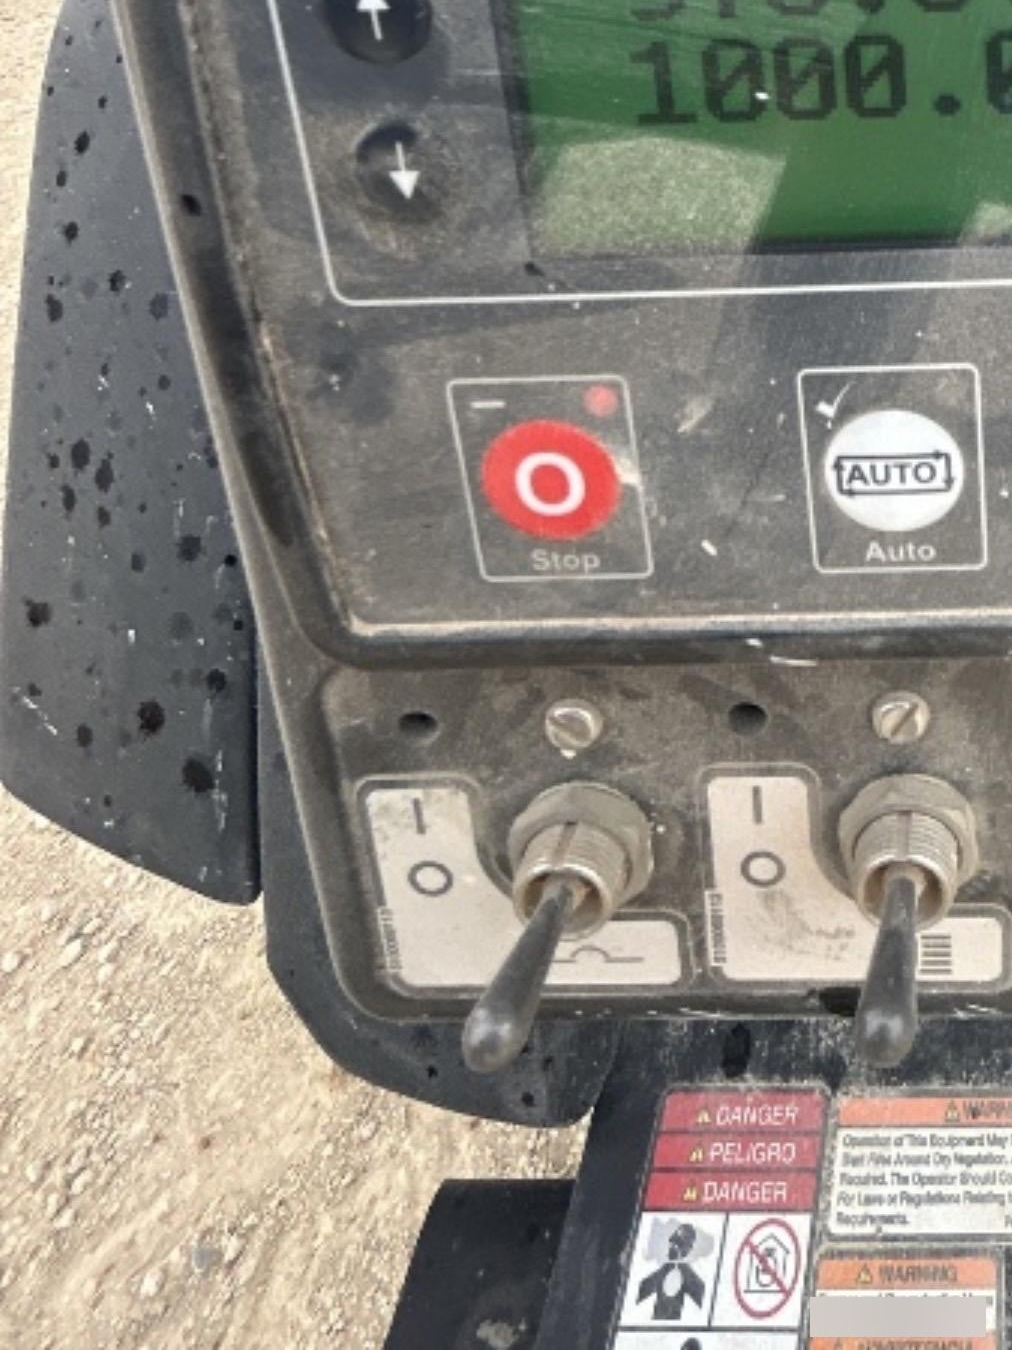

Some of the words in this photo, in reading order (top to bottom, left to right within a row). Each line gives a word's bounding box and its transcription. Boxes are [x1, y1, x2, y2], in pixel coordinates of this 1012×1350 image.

[846, 461, 937, 487] AUTO
[531, 547, 601, 576] Stop
[865, 540, 937, 563] Auto
[715, 1104, 800, 1127] DANGER
[708, 1141, 798, 1165] PELIGRO
[702, 1180, 788, 1203] DANGER
[878, 1265, 958, 1283] WARNING
